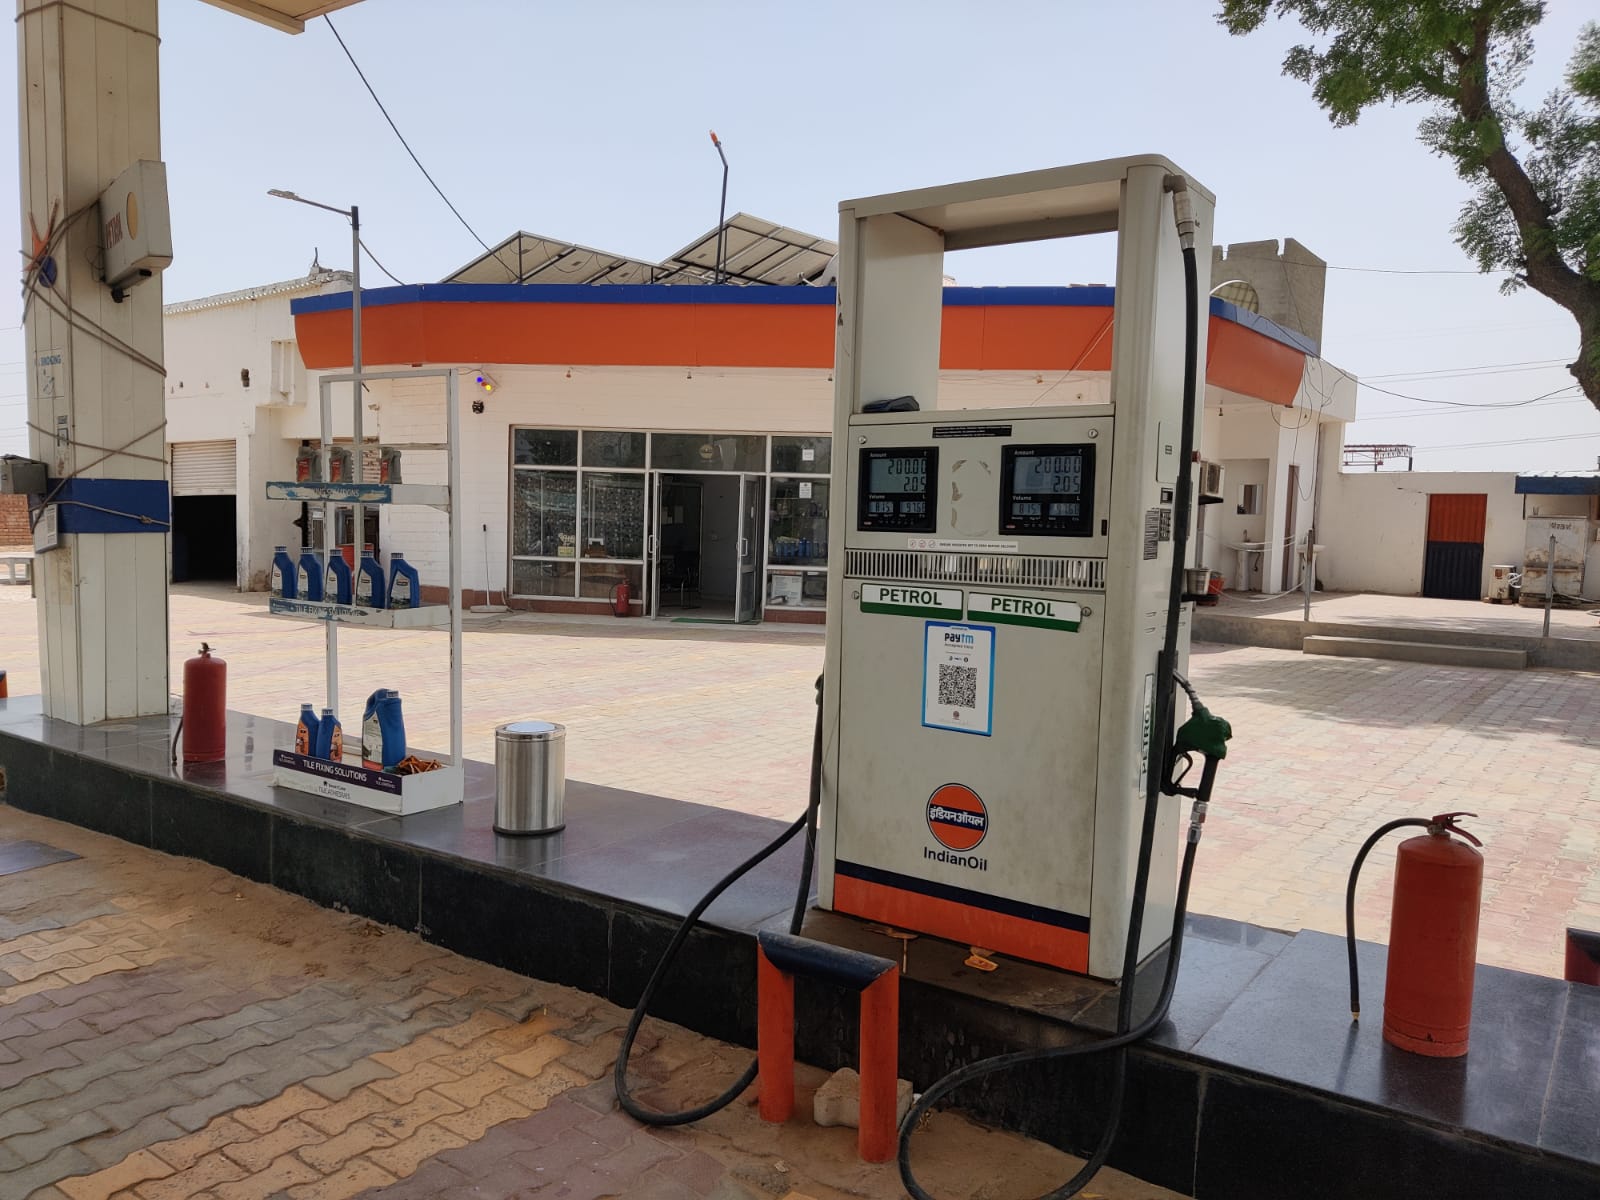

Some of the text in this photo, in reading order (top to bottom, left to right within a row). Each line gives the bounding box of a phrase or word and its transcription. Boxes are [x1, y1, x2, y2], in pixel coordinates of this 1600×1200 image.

[888, 458, 927, 475] 200.00
[1034, 456, 1081, 474] 200.00
[903, 476, 927, 492] 2.05
[1052, 475, 1081, 493] 2.05
[880, 588, 942, 606] PETROL
[991, 597, 1055, 617] PETROL
[303, 759, 316, 770] TILE
[315, 762, 334, 775] FIXING
[335, 765, 368, 782] SOLUTIONS
[929, 806, 985, 827] इंडियनऑयल
[923, 846, 988, 871] IndianOil
